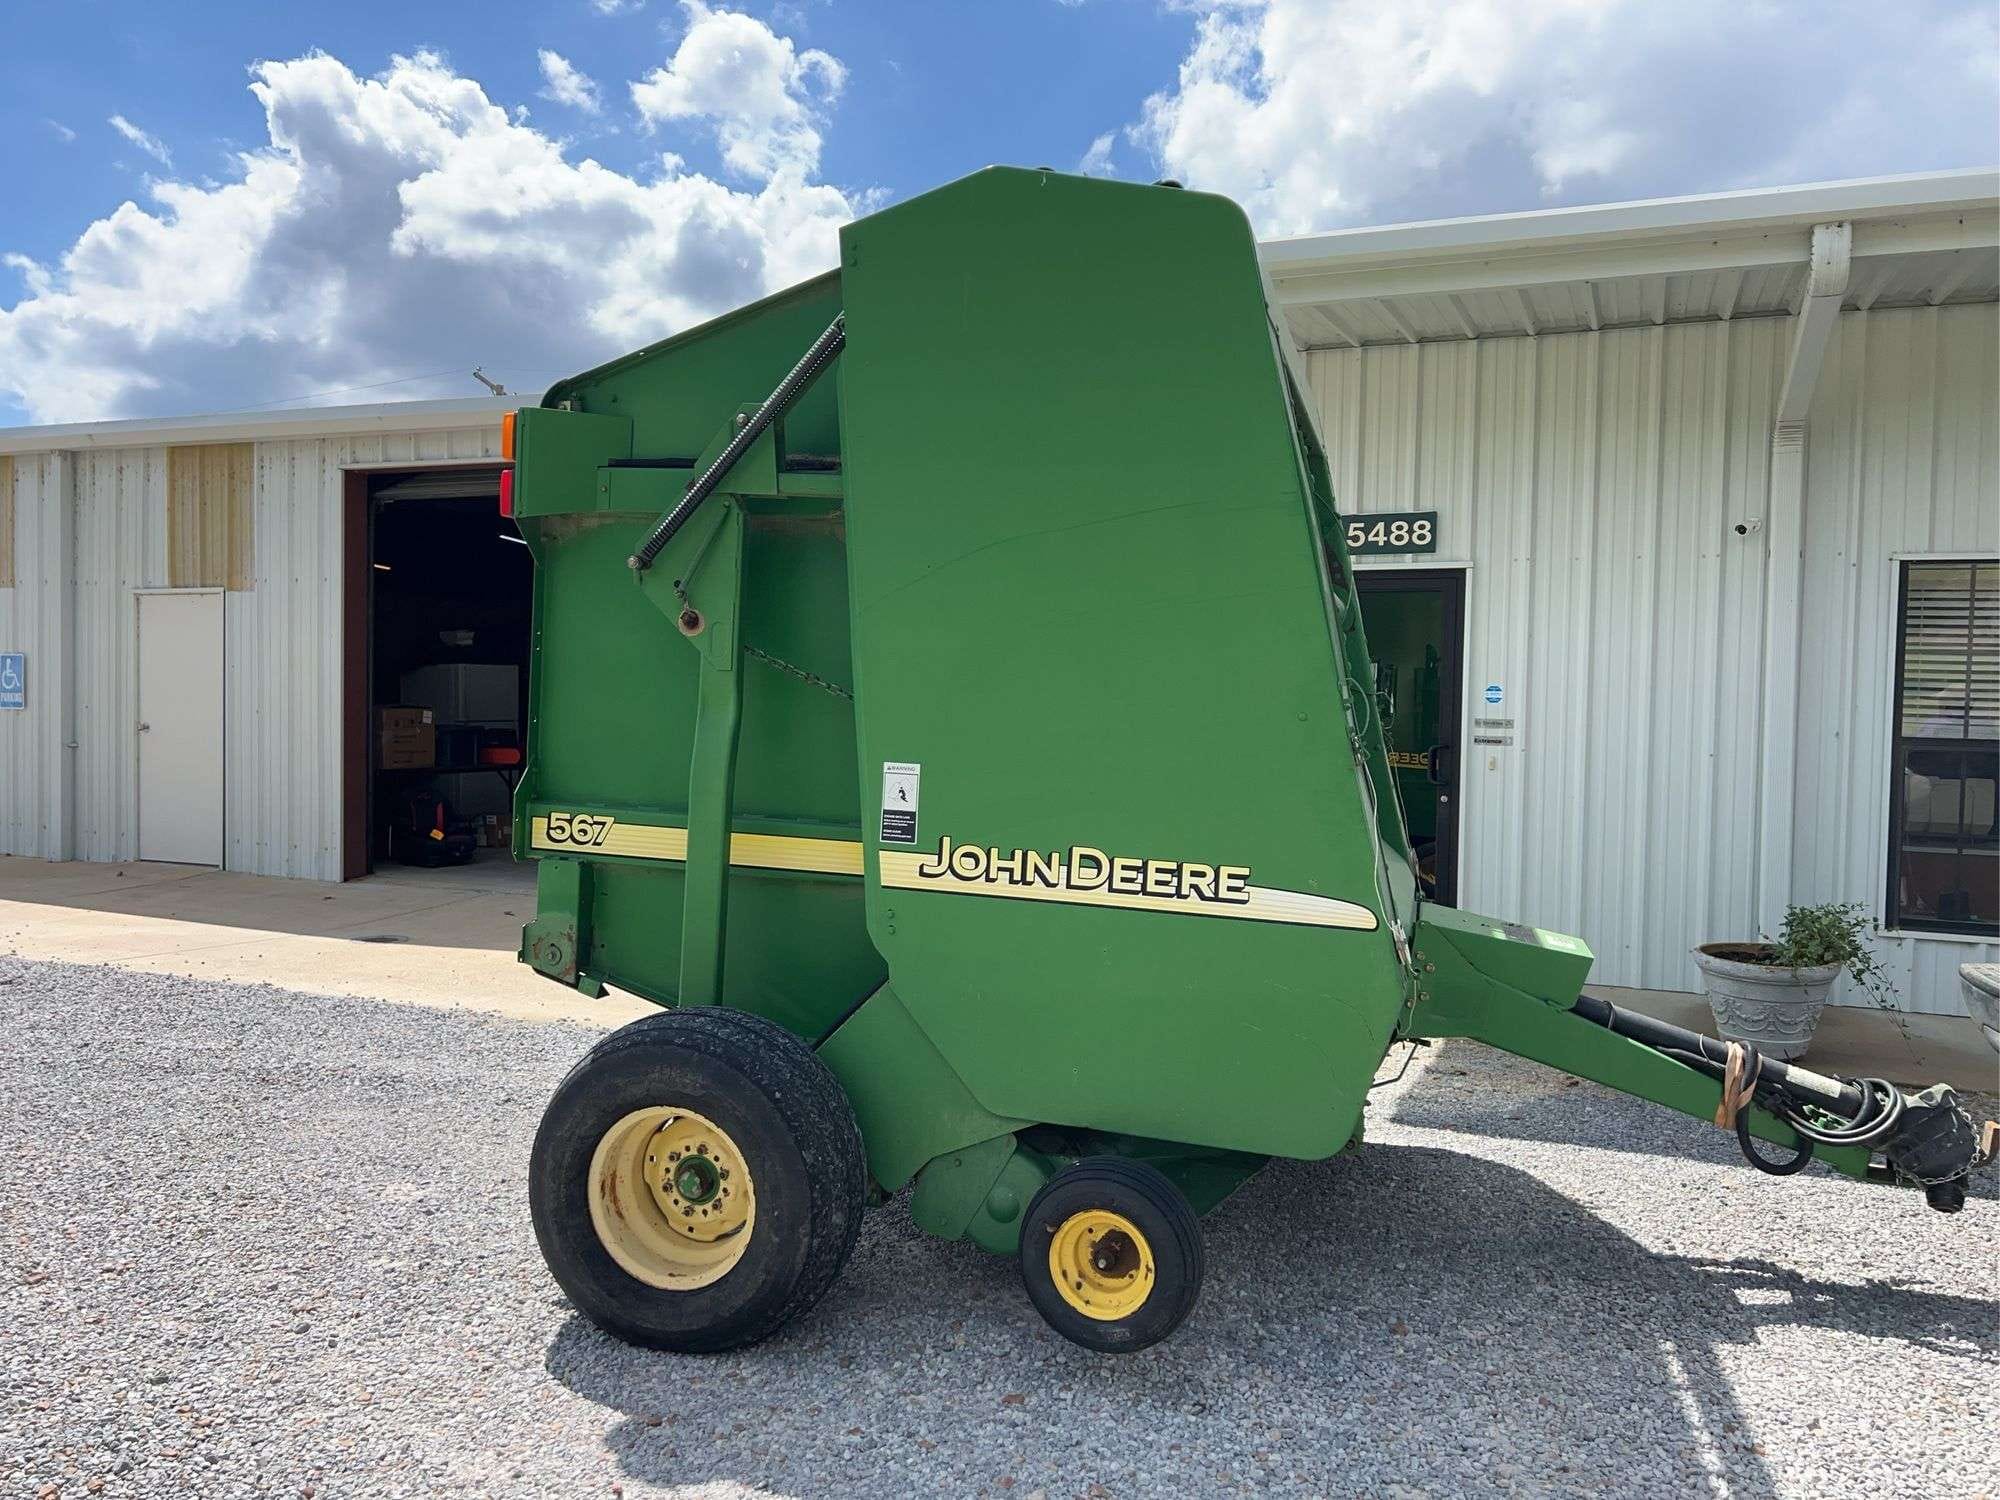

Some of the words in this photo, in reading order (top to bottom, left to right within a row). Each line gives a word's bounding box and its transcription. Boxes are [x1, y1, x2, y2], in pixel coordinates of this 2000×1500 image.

[1346, 520, 1432, 547] 5488
[547, 812, 615, 846] 567
[919, 836, 1061, 887] JOHN
[1066, 845, 1250, 904] DEERE
